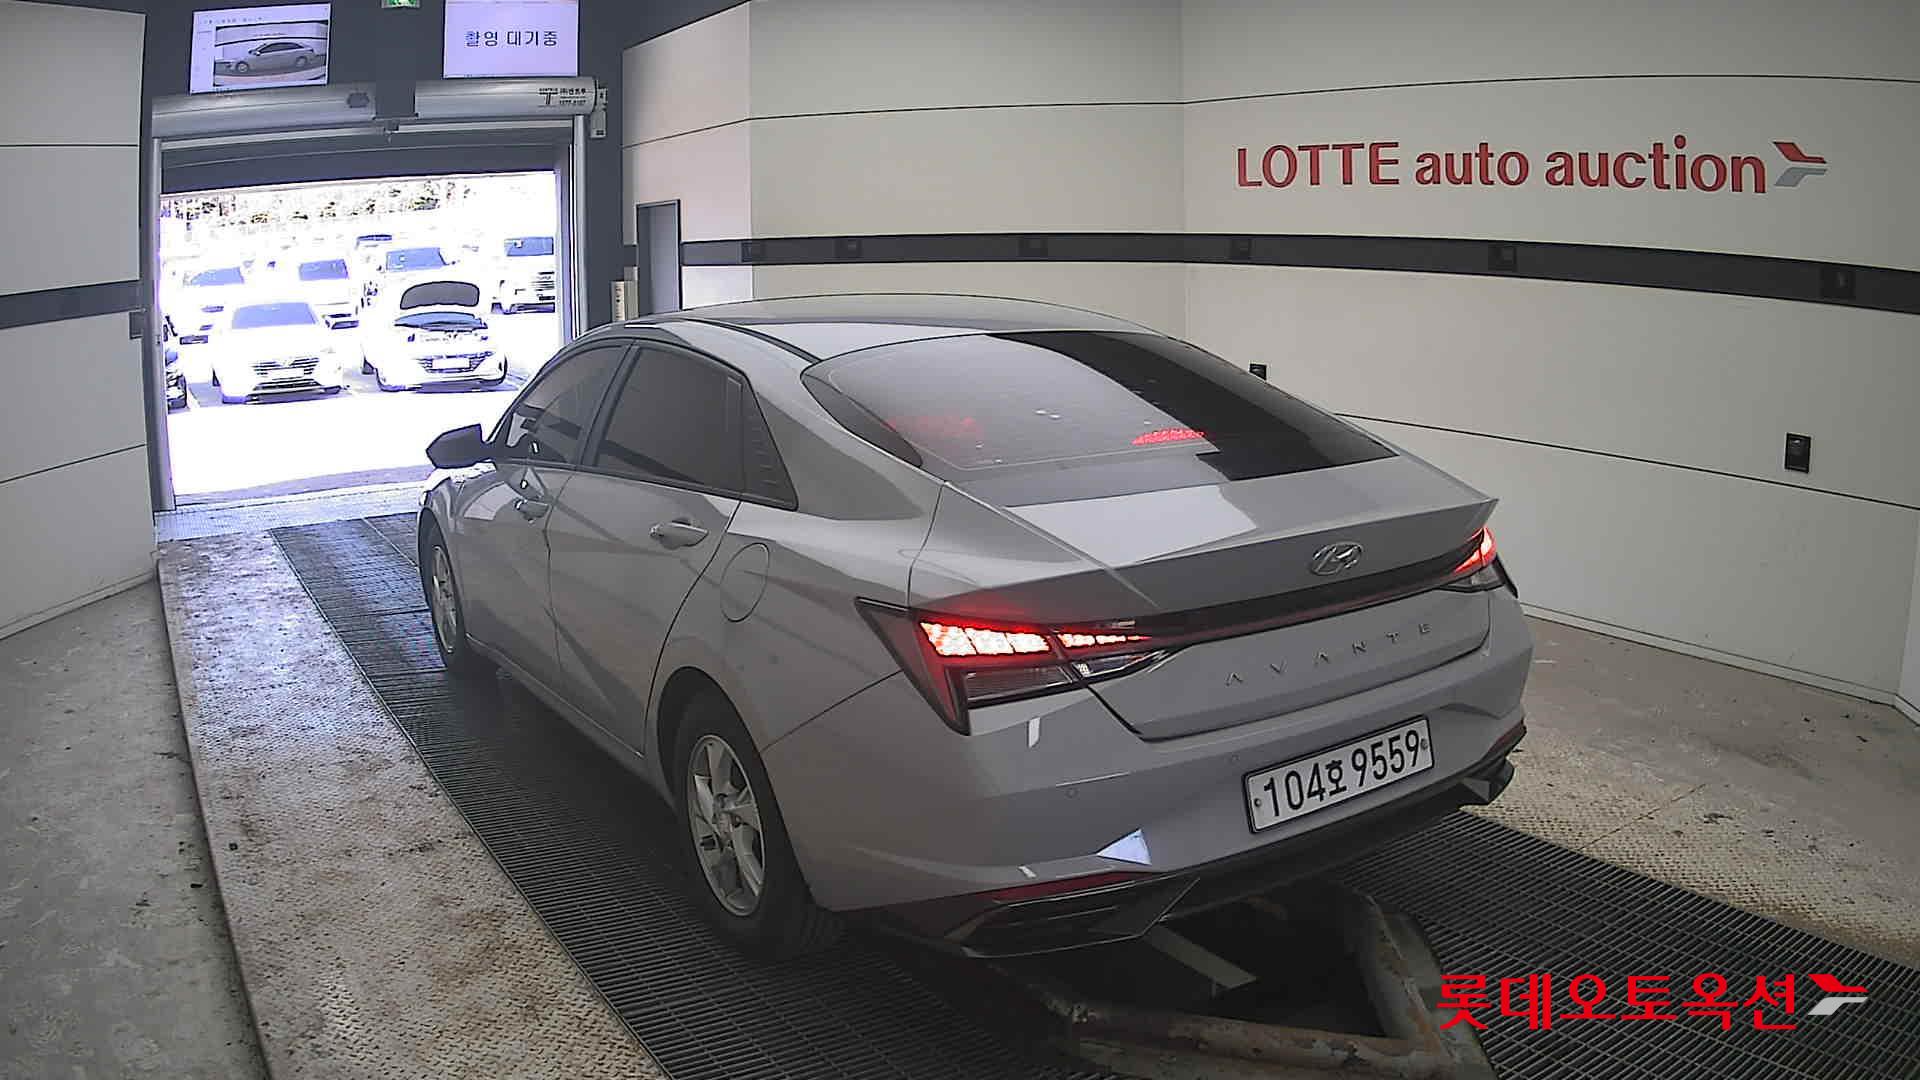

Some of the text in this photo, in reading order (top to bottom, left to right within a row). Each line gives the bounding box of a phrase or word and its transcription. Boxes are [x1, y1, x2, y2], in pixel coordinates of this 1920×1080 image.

[506, 31, 558, 47] 대기중
[1237, 134, 1766, 194] LOTTE auto auction
[1225, 623, 1431, 686] AVANTE
[1351, 729, 1420, 788] 9559
